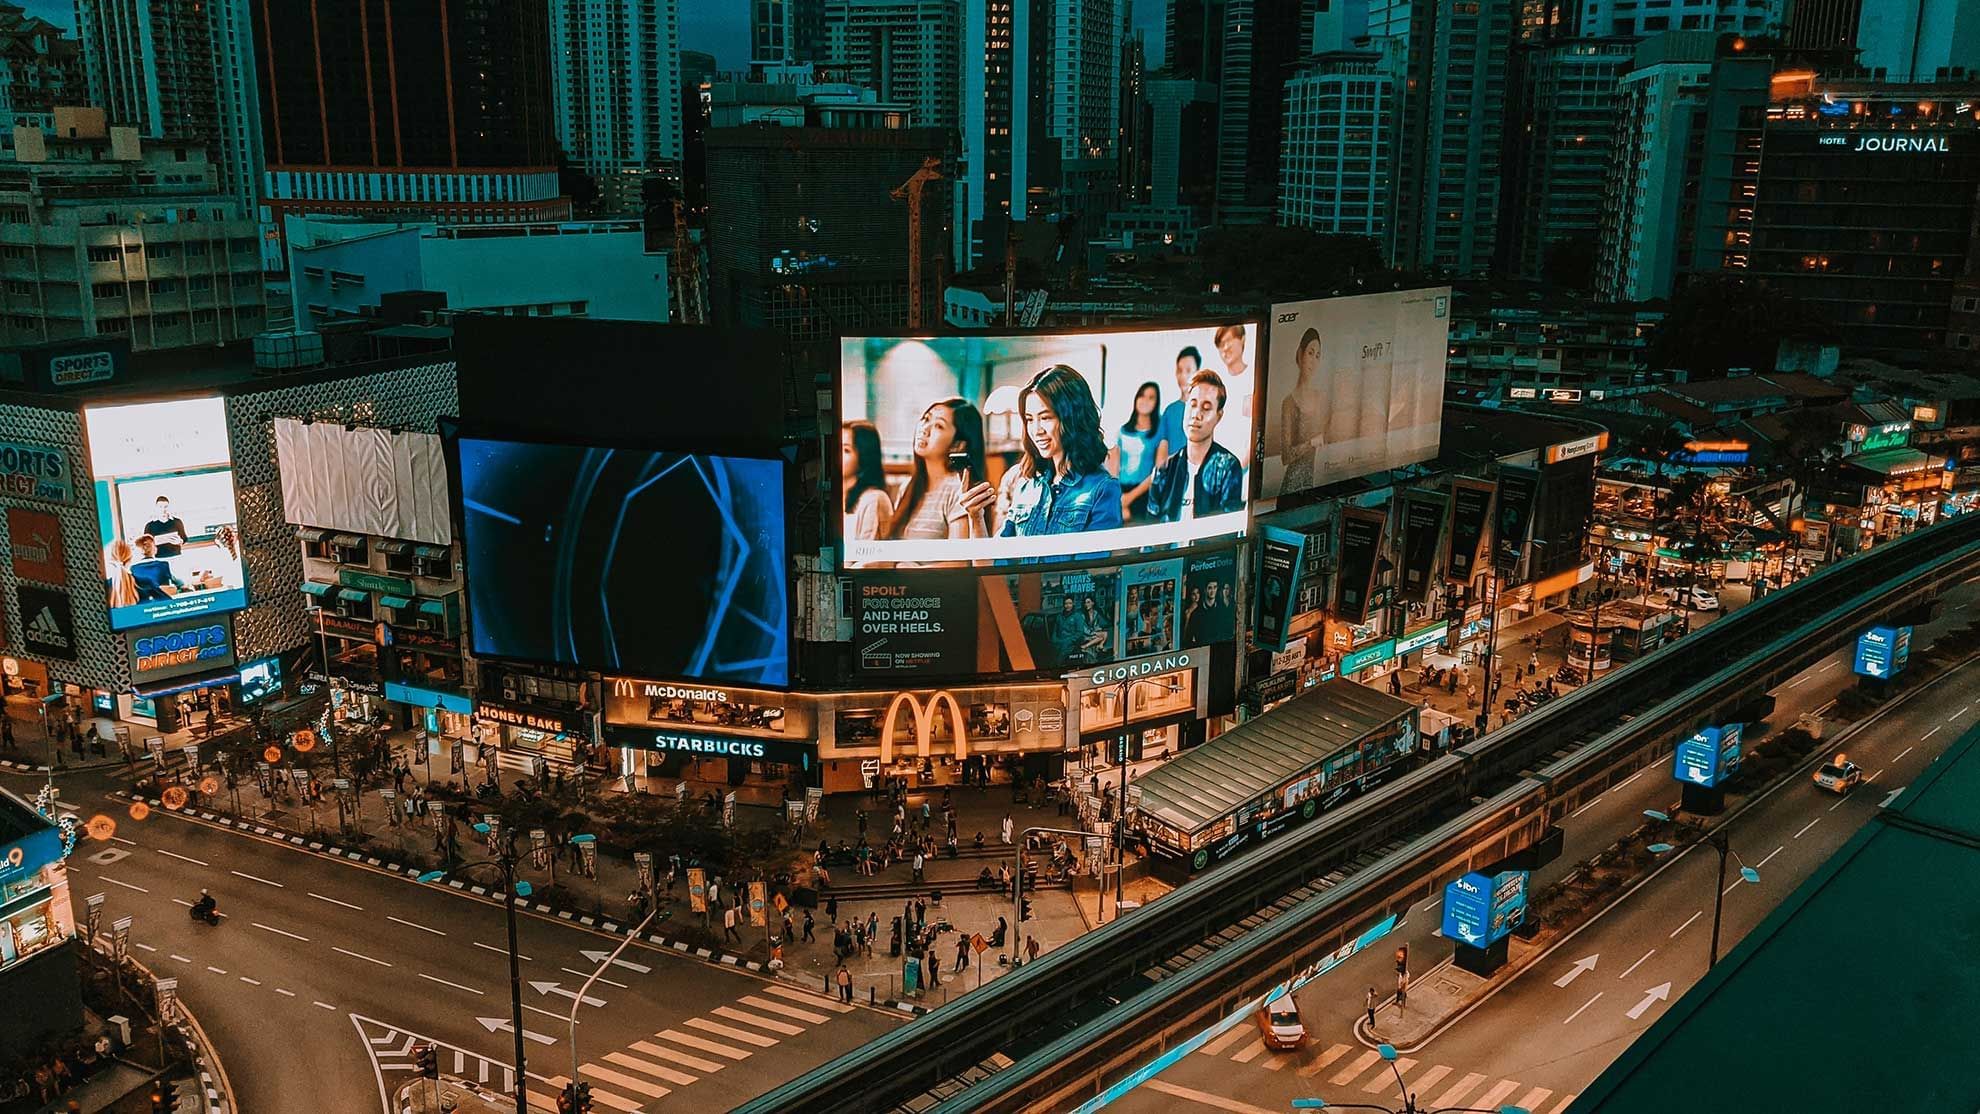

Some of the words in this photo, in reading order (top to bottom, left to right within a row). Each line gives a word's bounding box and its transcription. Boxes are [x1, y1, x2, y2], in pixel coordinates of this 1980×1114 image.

[1855, 138, 1949, 152] JOURNAL
[1278, 313, 1299, 324] acer
[1361, 342, 1384, 360] Swift
[55, 354, 110, 372] SPORTS
[1190, 561, 1217, 573] Perfect
[1062, 574, 1092, 585] ALWAYS
[863, 586, 907, 596] SPOILT
[1070, 582, 1096, 593] MAYBE
[862, 598, 889, 609] FOR
[891, 597, 941, 609] CHOICE
[862, 611, 890, 621] AND
[893, 610, 929, 620] HEAD
[862, 623, 898, 634] OVER
[900, 622, 945, 633] HEELS.
[26, 630, 68, 648] adidas
[135, 625, 225, 656] SPORTS
[1092, 654, 1190, 685] GIORDANO
[645, 684, 727, 702] McDonald's
[480, 705, 524, 725] HONEY
[526, 715, 562, 732] BAKE
[656, 735, 764, 757] STARBUCKS
